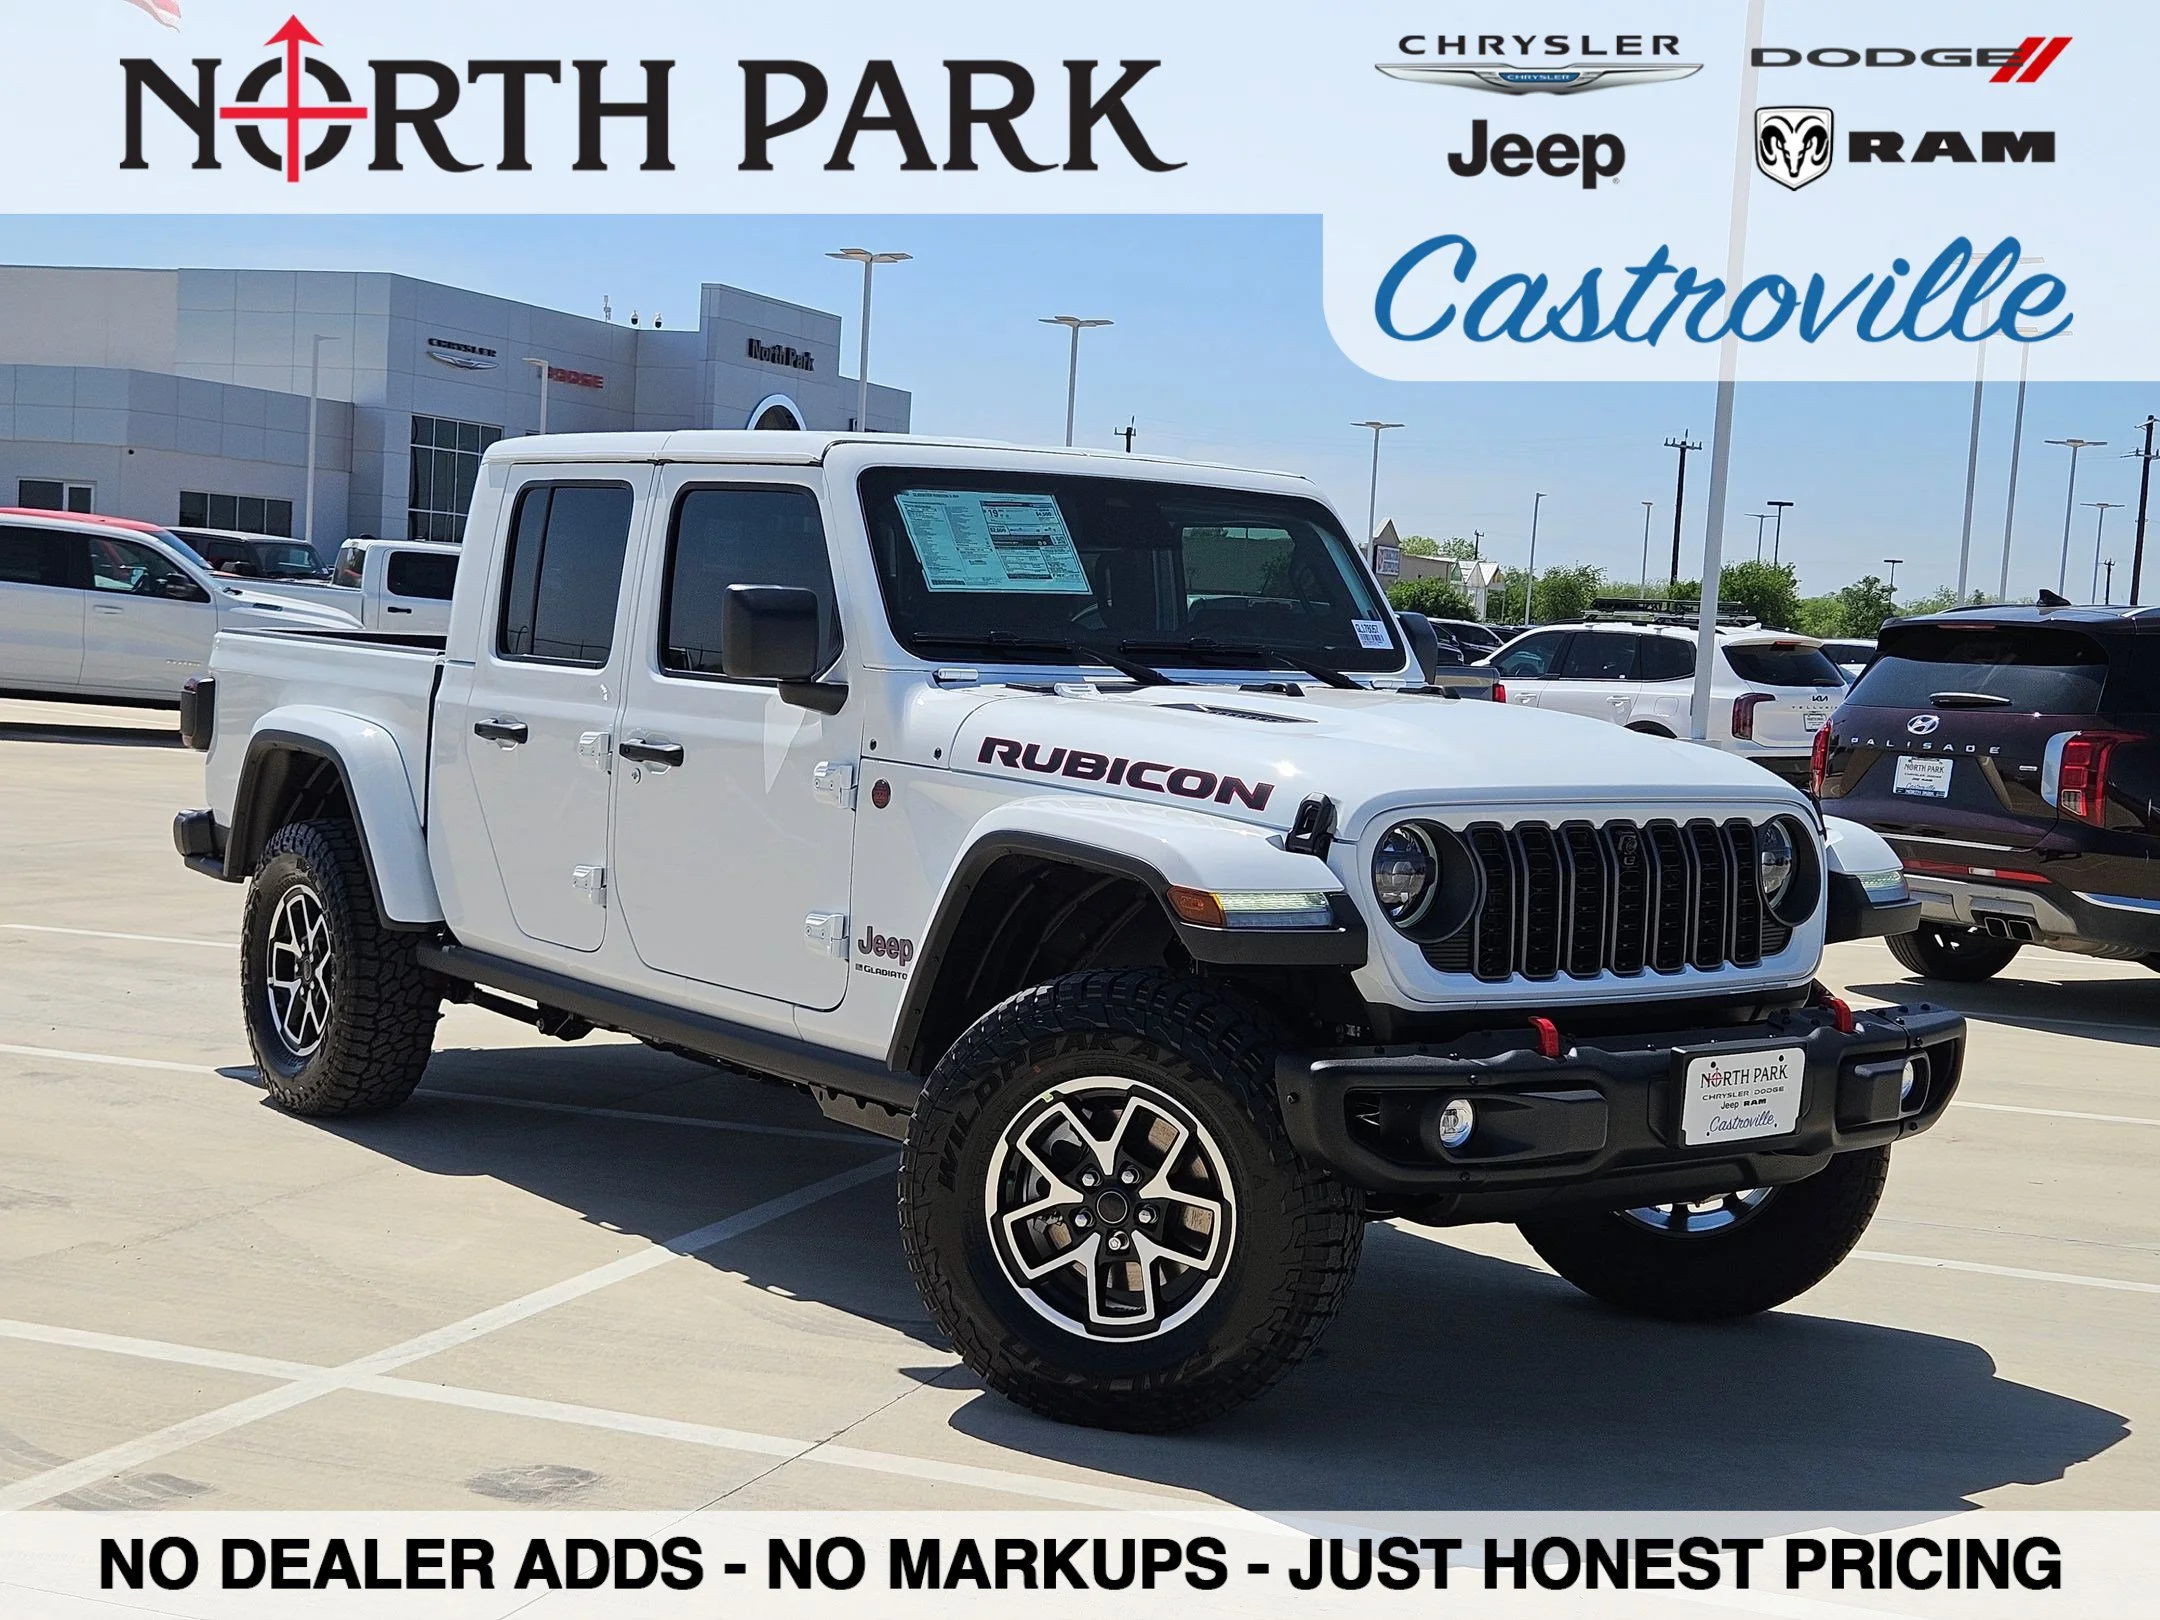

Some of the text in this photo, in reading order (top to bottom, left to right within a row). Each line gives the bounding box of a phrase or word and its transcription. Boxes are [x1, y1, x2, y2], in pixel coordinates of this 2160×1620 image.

[748, 338, 815, 371] North Park
[1850, 737, 2001, 754] PALISADE
[976, 735, 1276, 812] RUBICON
[1904, 763, 1945, 773] NORTH PARK
[857, 925, 914, 967] Jeep
[1700, 1064, 1788, 1089] NORTH PARK
[1702, 1086, 1785, 1101] CHRYSLER DODGE
[1720, 1098, 1767, 1110] Jeep RAM
[1709, 1110, 1775, 1133] Castroville
